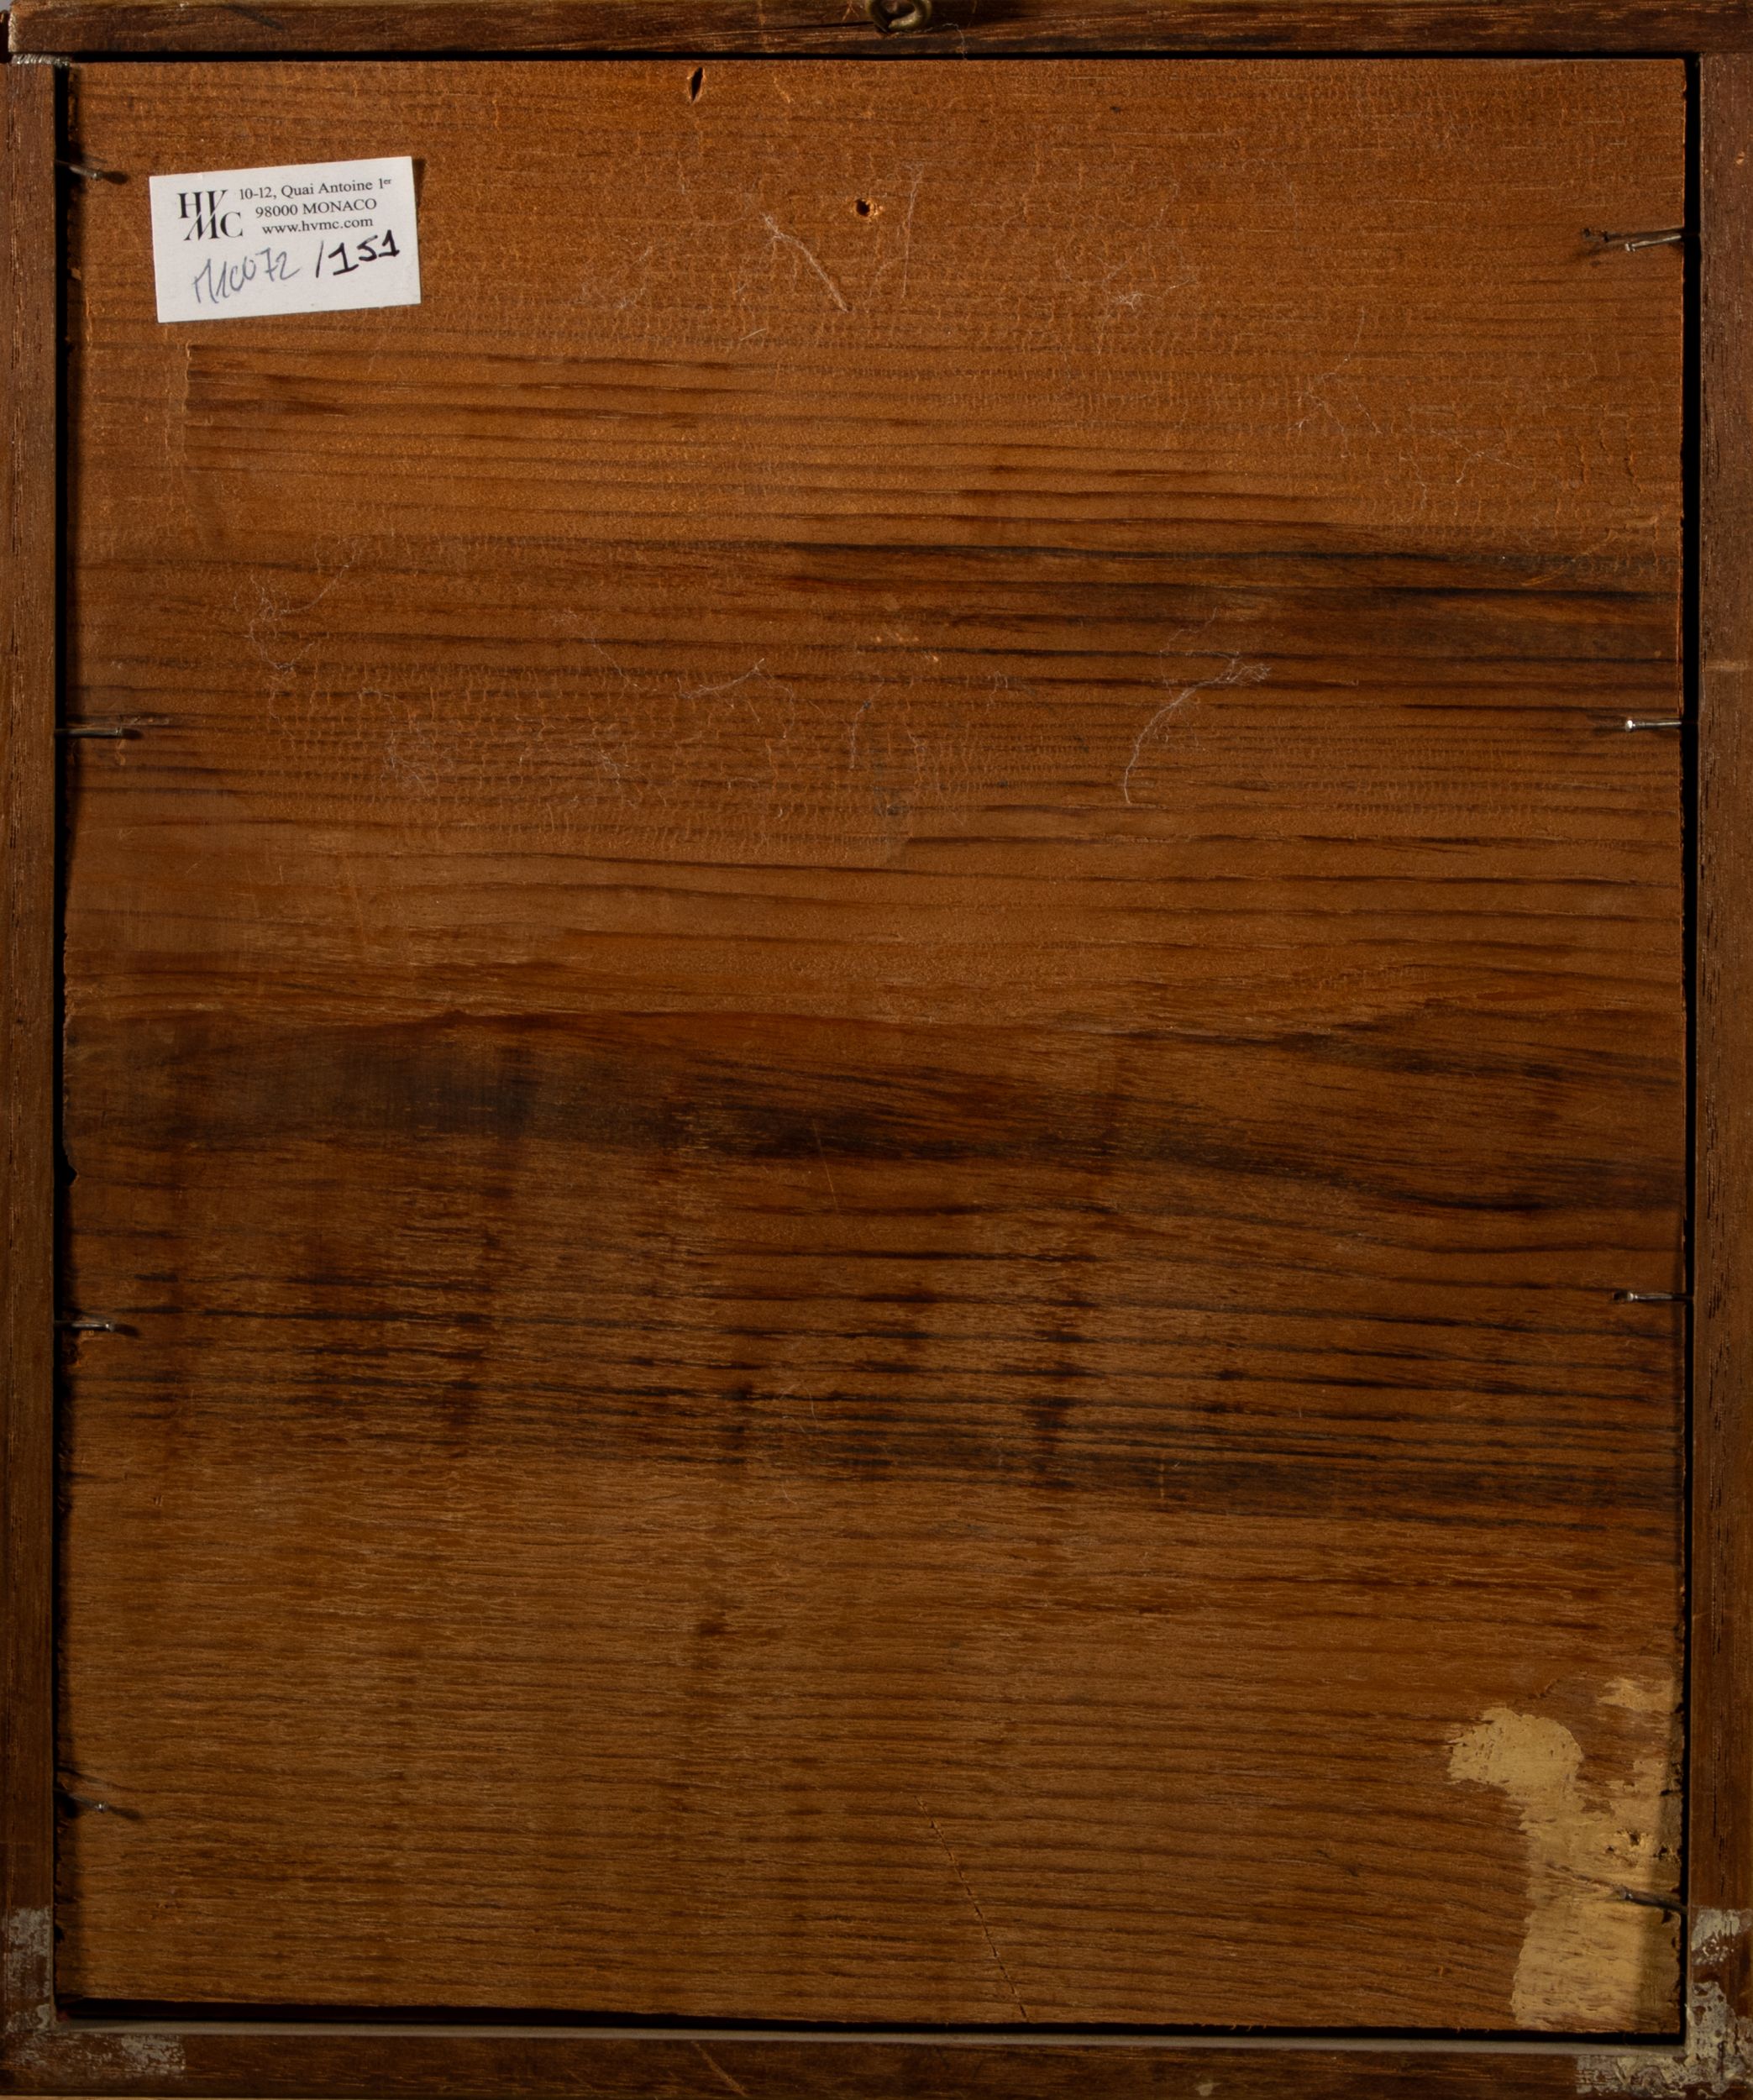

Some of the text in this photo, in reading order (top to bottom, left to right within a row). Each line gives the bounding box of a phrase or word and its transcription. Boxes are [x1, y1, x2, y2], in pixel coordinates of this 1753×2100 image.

[239, 177, 392, 201] 10-12, Quai Antoine 1er
[255, 197, 377, 218] 98000 MONACO
[261, 217, 373, 234] www.hvmc.com
